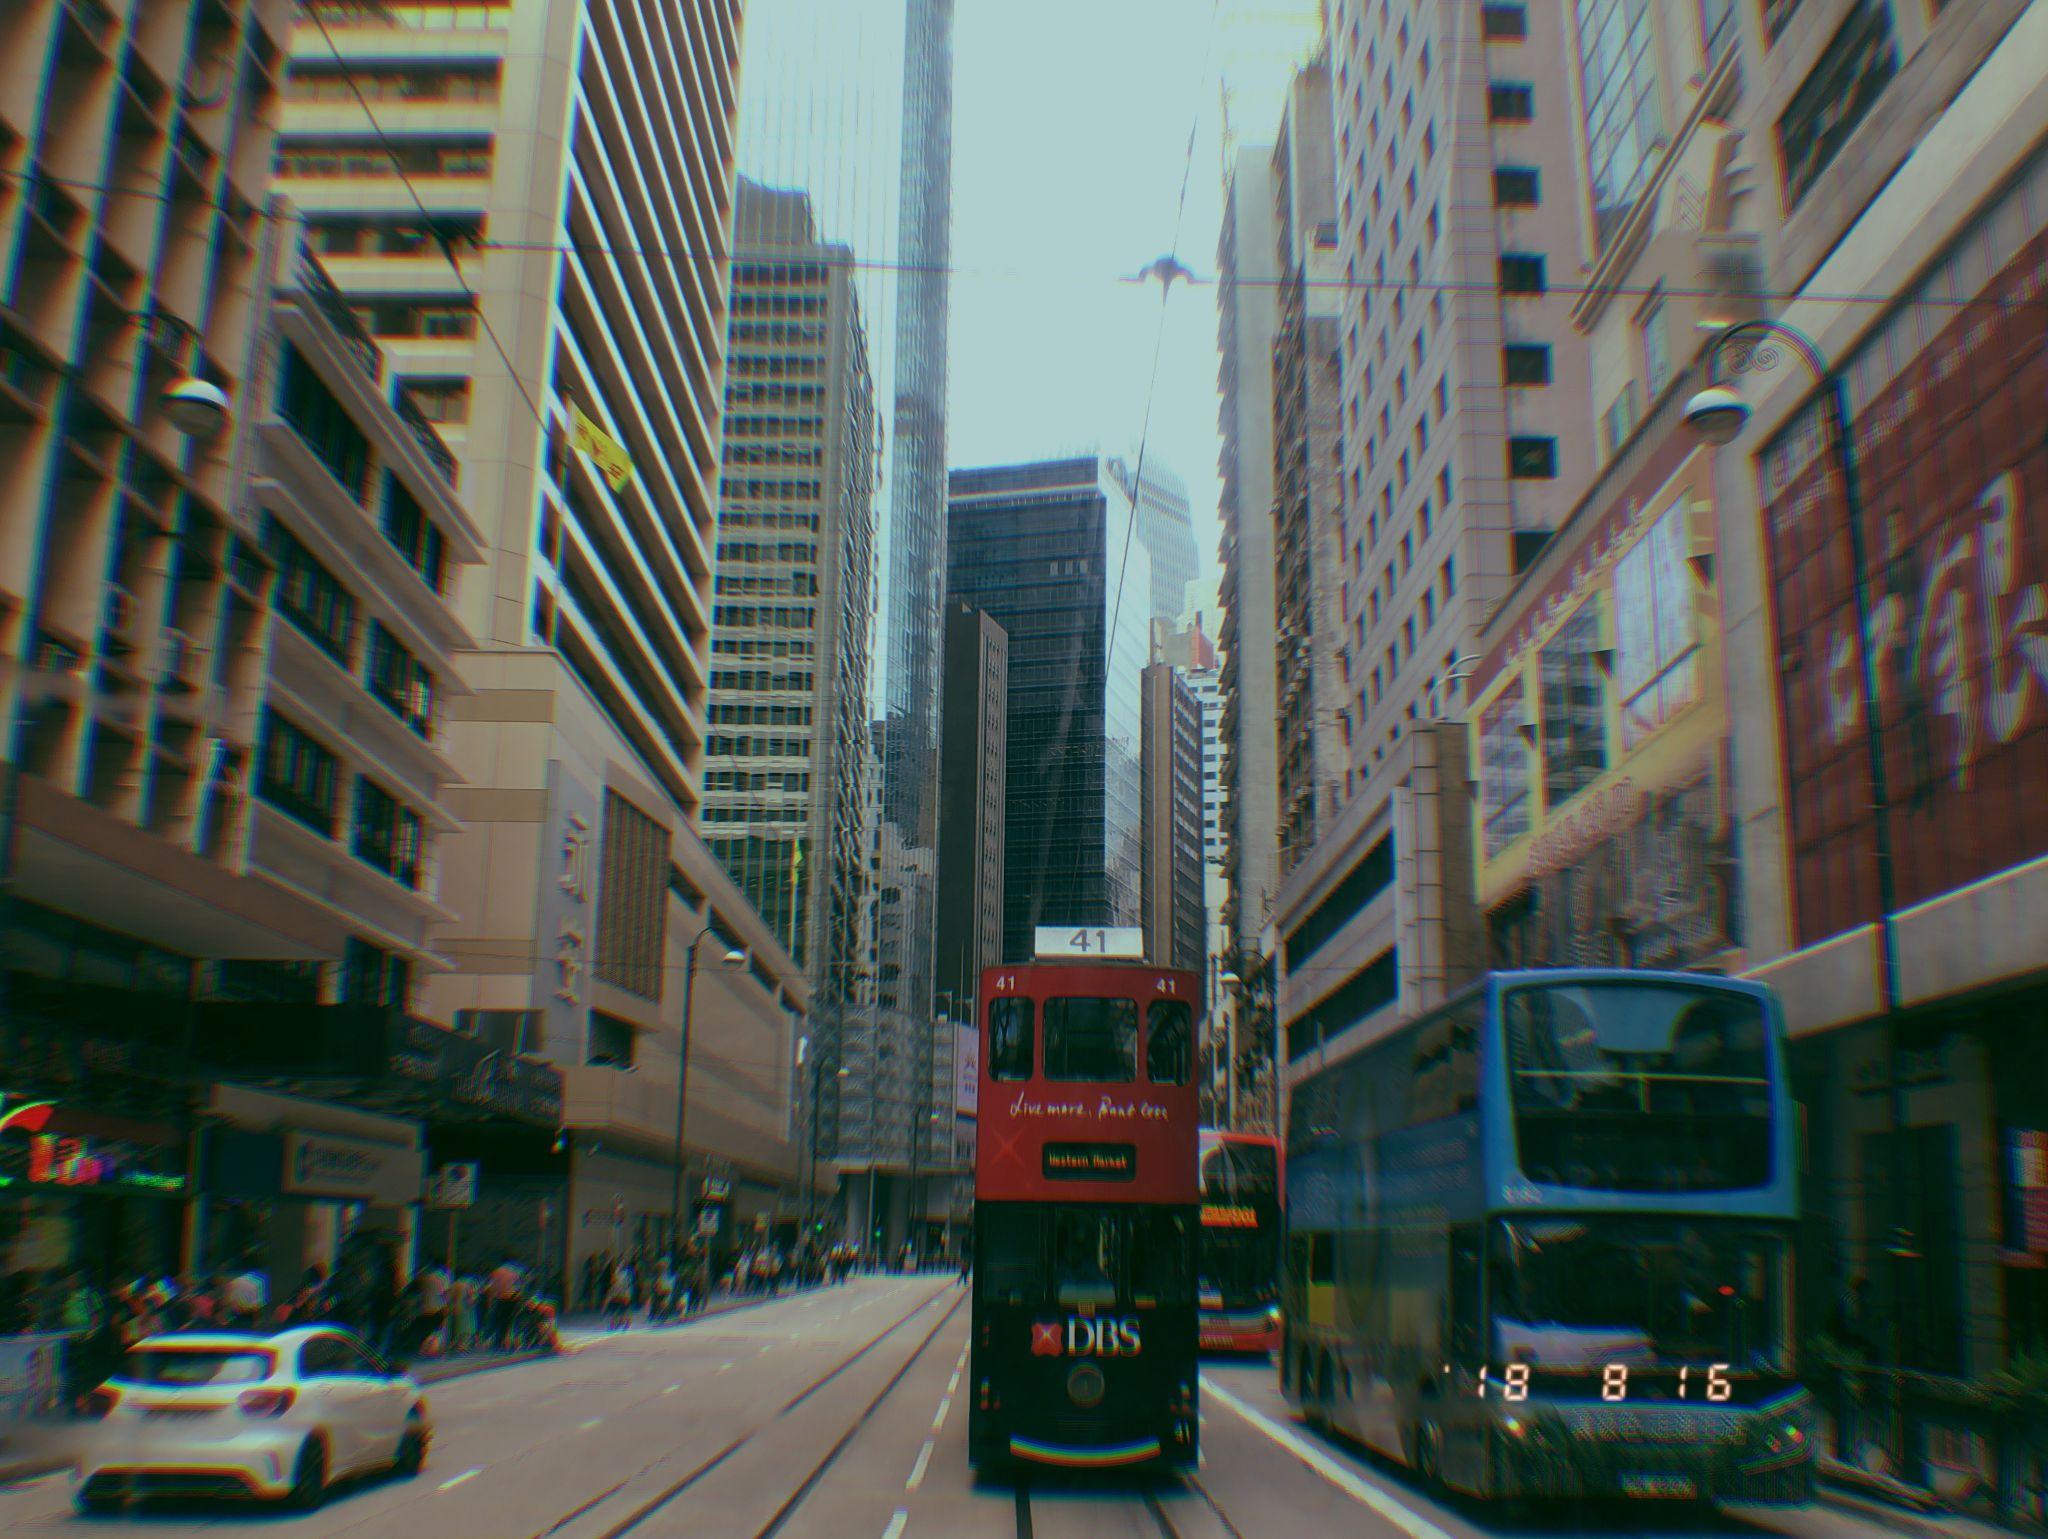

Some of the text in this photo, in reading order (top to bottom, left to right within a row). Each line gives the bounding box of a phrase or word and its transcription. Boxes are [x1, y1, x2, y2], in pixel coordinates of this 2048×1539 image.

[1069, 928, 1106, 953] 41
[997, 976, 1016, 992] 41
[1157, 978, 1176, 995] 41
[1068, 1315, 1142, 1357] DBS
